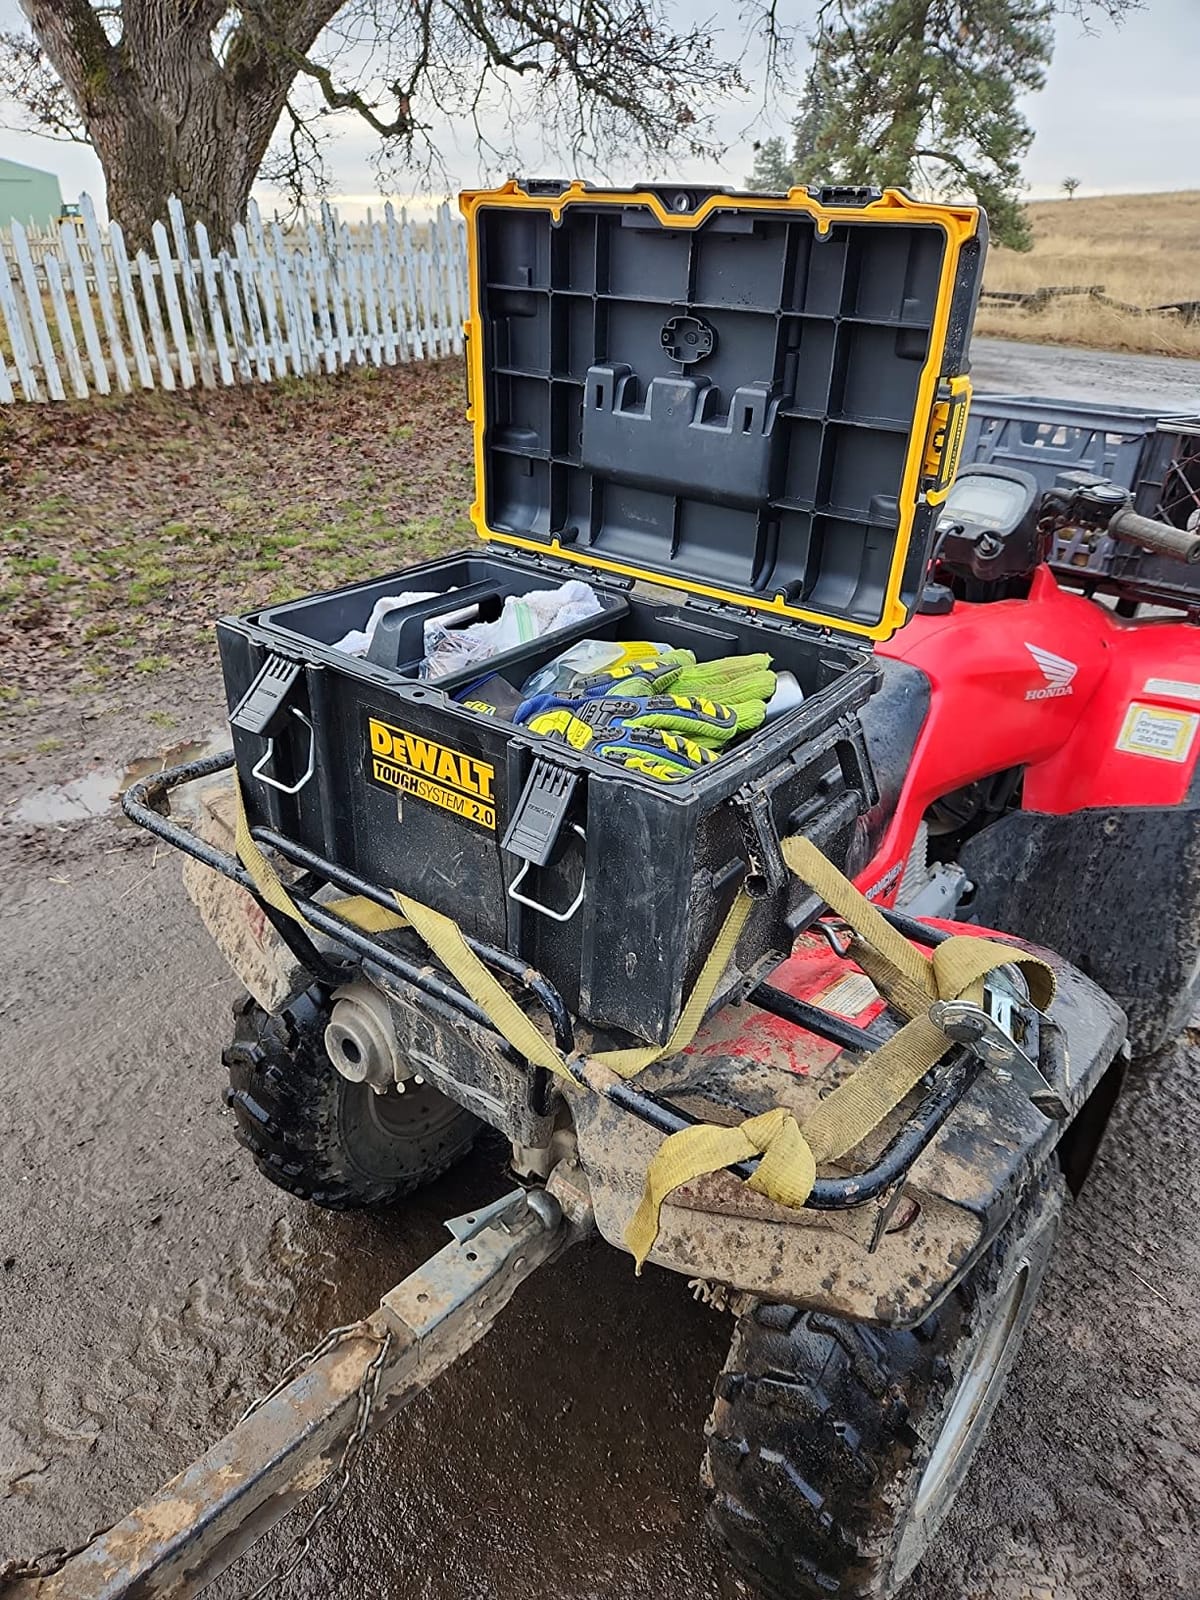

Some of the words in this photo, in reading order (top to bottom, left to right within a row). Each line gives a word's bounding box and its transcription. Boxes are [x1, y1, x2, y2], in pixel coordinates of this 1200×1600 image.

[1024, 685, 1074, 701] HONDA
[375, 762, 466, 813] TOUGHSYSTEM
[471, 803, 494, 826] 2.0
